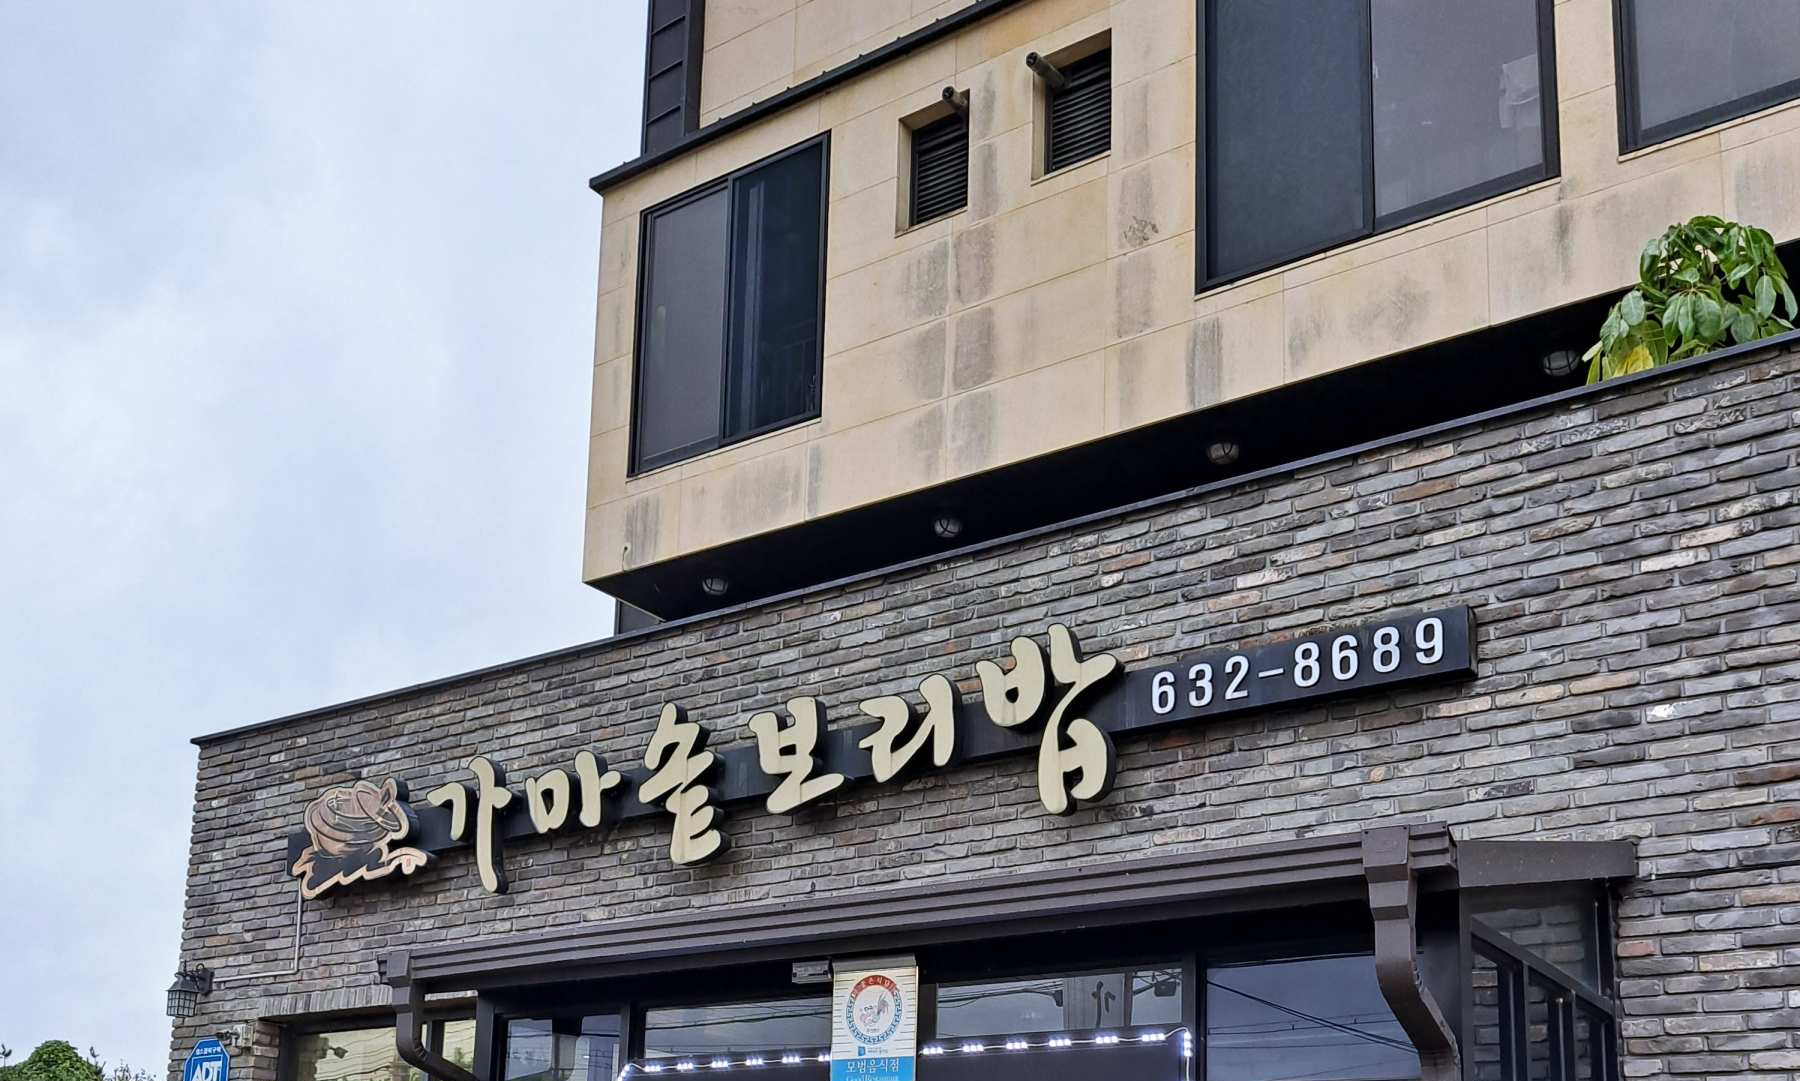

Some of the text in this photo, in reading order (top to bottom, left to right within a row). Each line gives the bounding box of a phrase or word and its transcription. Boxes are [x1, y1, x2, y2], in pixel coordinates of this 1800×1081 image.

[1151, 617, 1445, 715] 632-8689
[427, 622, 1119, 894] 가마솥보리밥
[845, 1058, 899, 1073] 모범음식점
